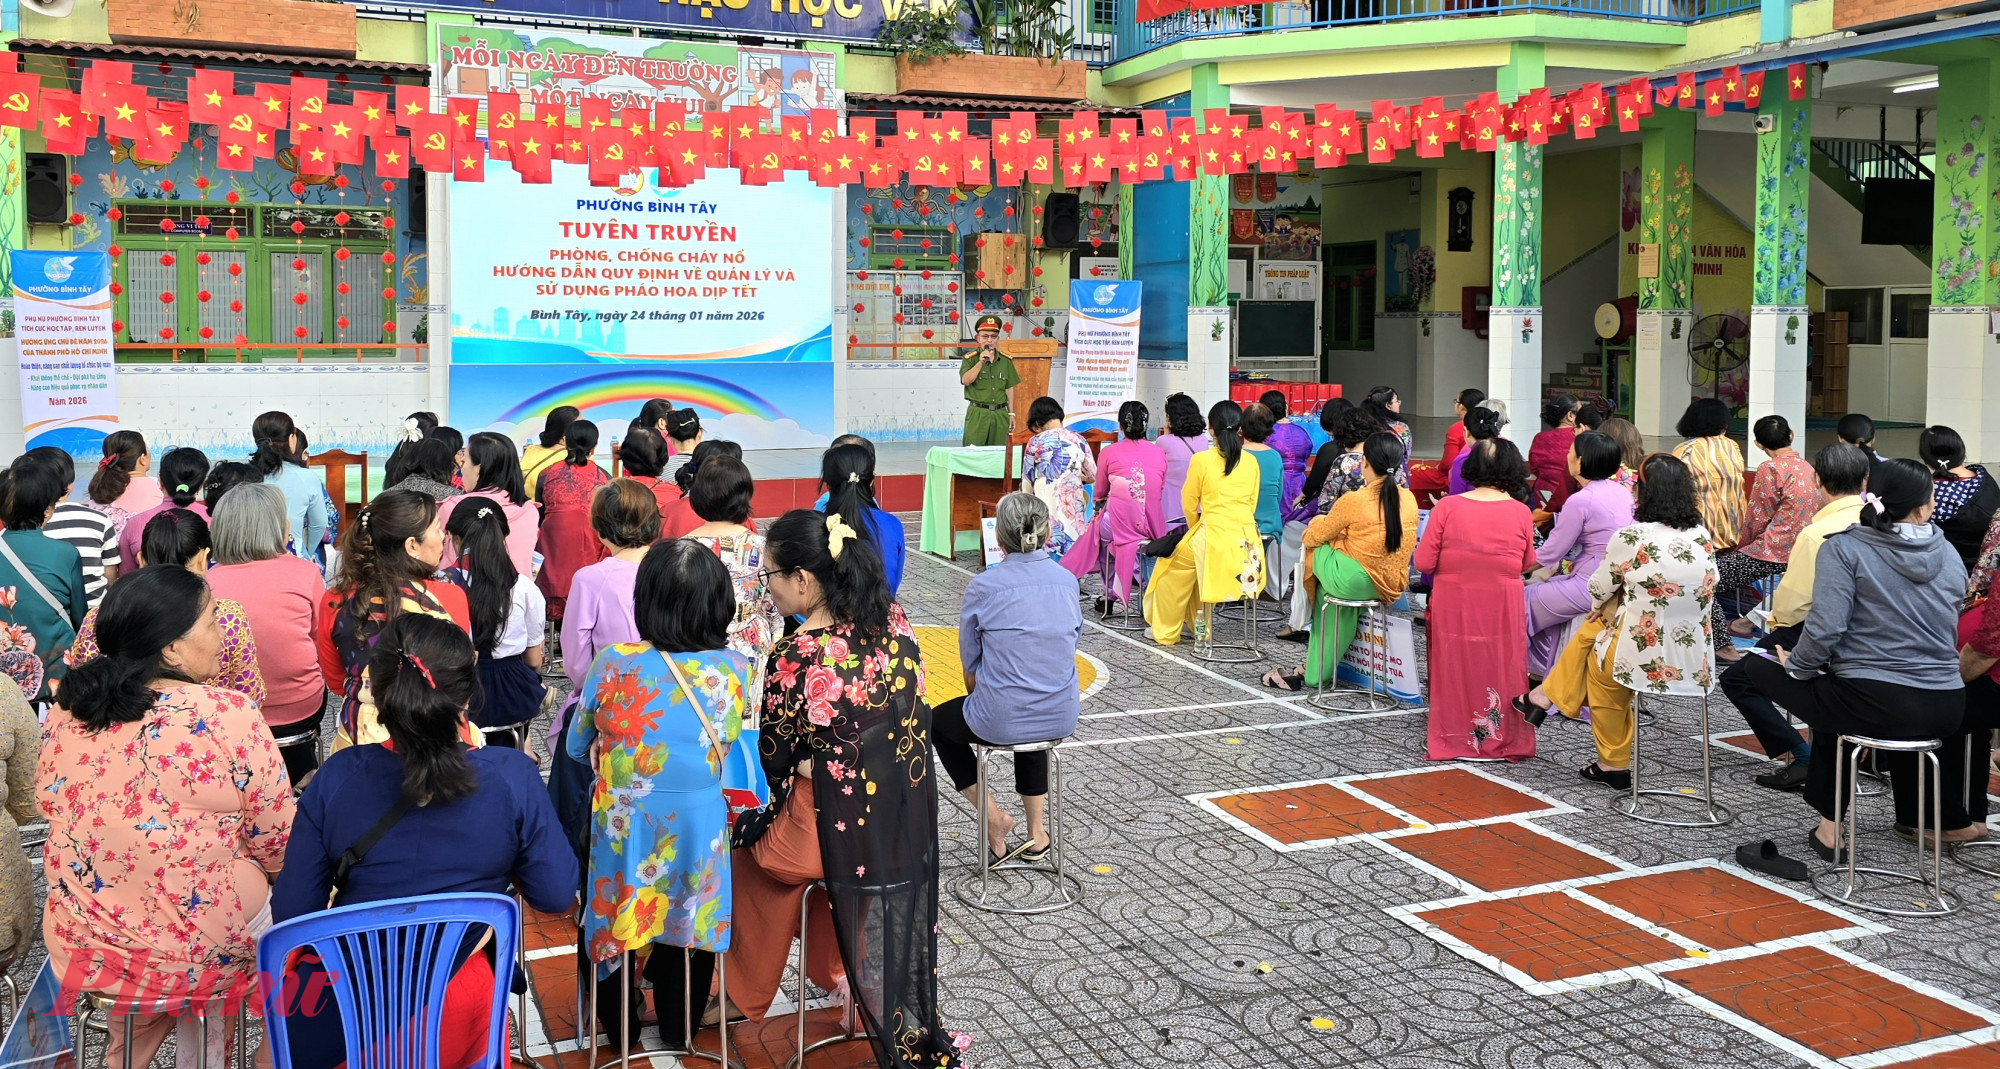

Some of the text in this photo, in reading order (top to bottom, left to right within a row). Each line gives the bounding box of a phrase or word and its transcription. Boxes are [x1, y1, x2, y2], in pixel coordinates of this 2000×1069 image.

[453, 39, 738, 83] MỖI NGÀY ĐẾN TRƯỜNG
[577, 199, 717, 214] PHƯỜNG BÌNH TÂY
[559, 218, 736, 242] TUYÊN TRUYỀN
[549, 247, 745, 264] PHÒNG, CHỐNG CHÁY NỔ
[1700, 243, 1721, 258] VĂN
[1725, 244, 1746, 258] HÓA
[493, 262, 795, 283] HƯỚNG DẪN QUY ĐỊNH VỀ QUẢN LÝ VÀ
[1693, 263, 1722, 275] MINH
[28, 284, 92, 293] PHƯỜNG BÌNH TÂY
[536, 281, 758, 300] SỬ DỤNG PHÁO HOA DỊP TẾT
[531, 309, 765, 323] Bình Tây, ngày 24 tháng 01 năm 2026
[49, 396, 87, 406] Năm 2026
